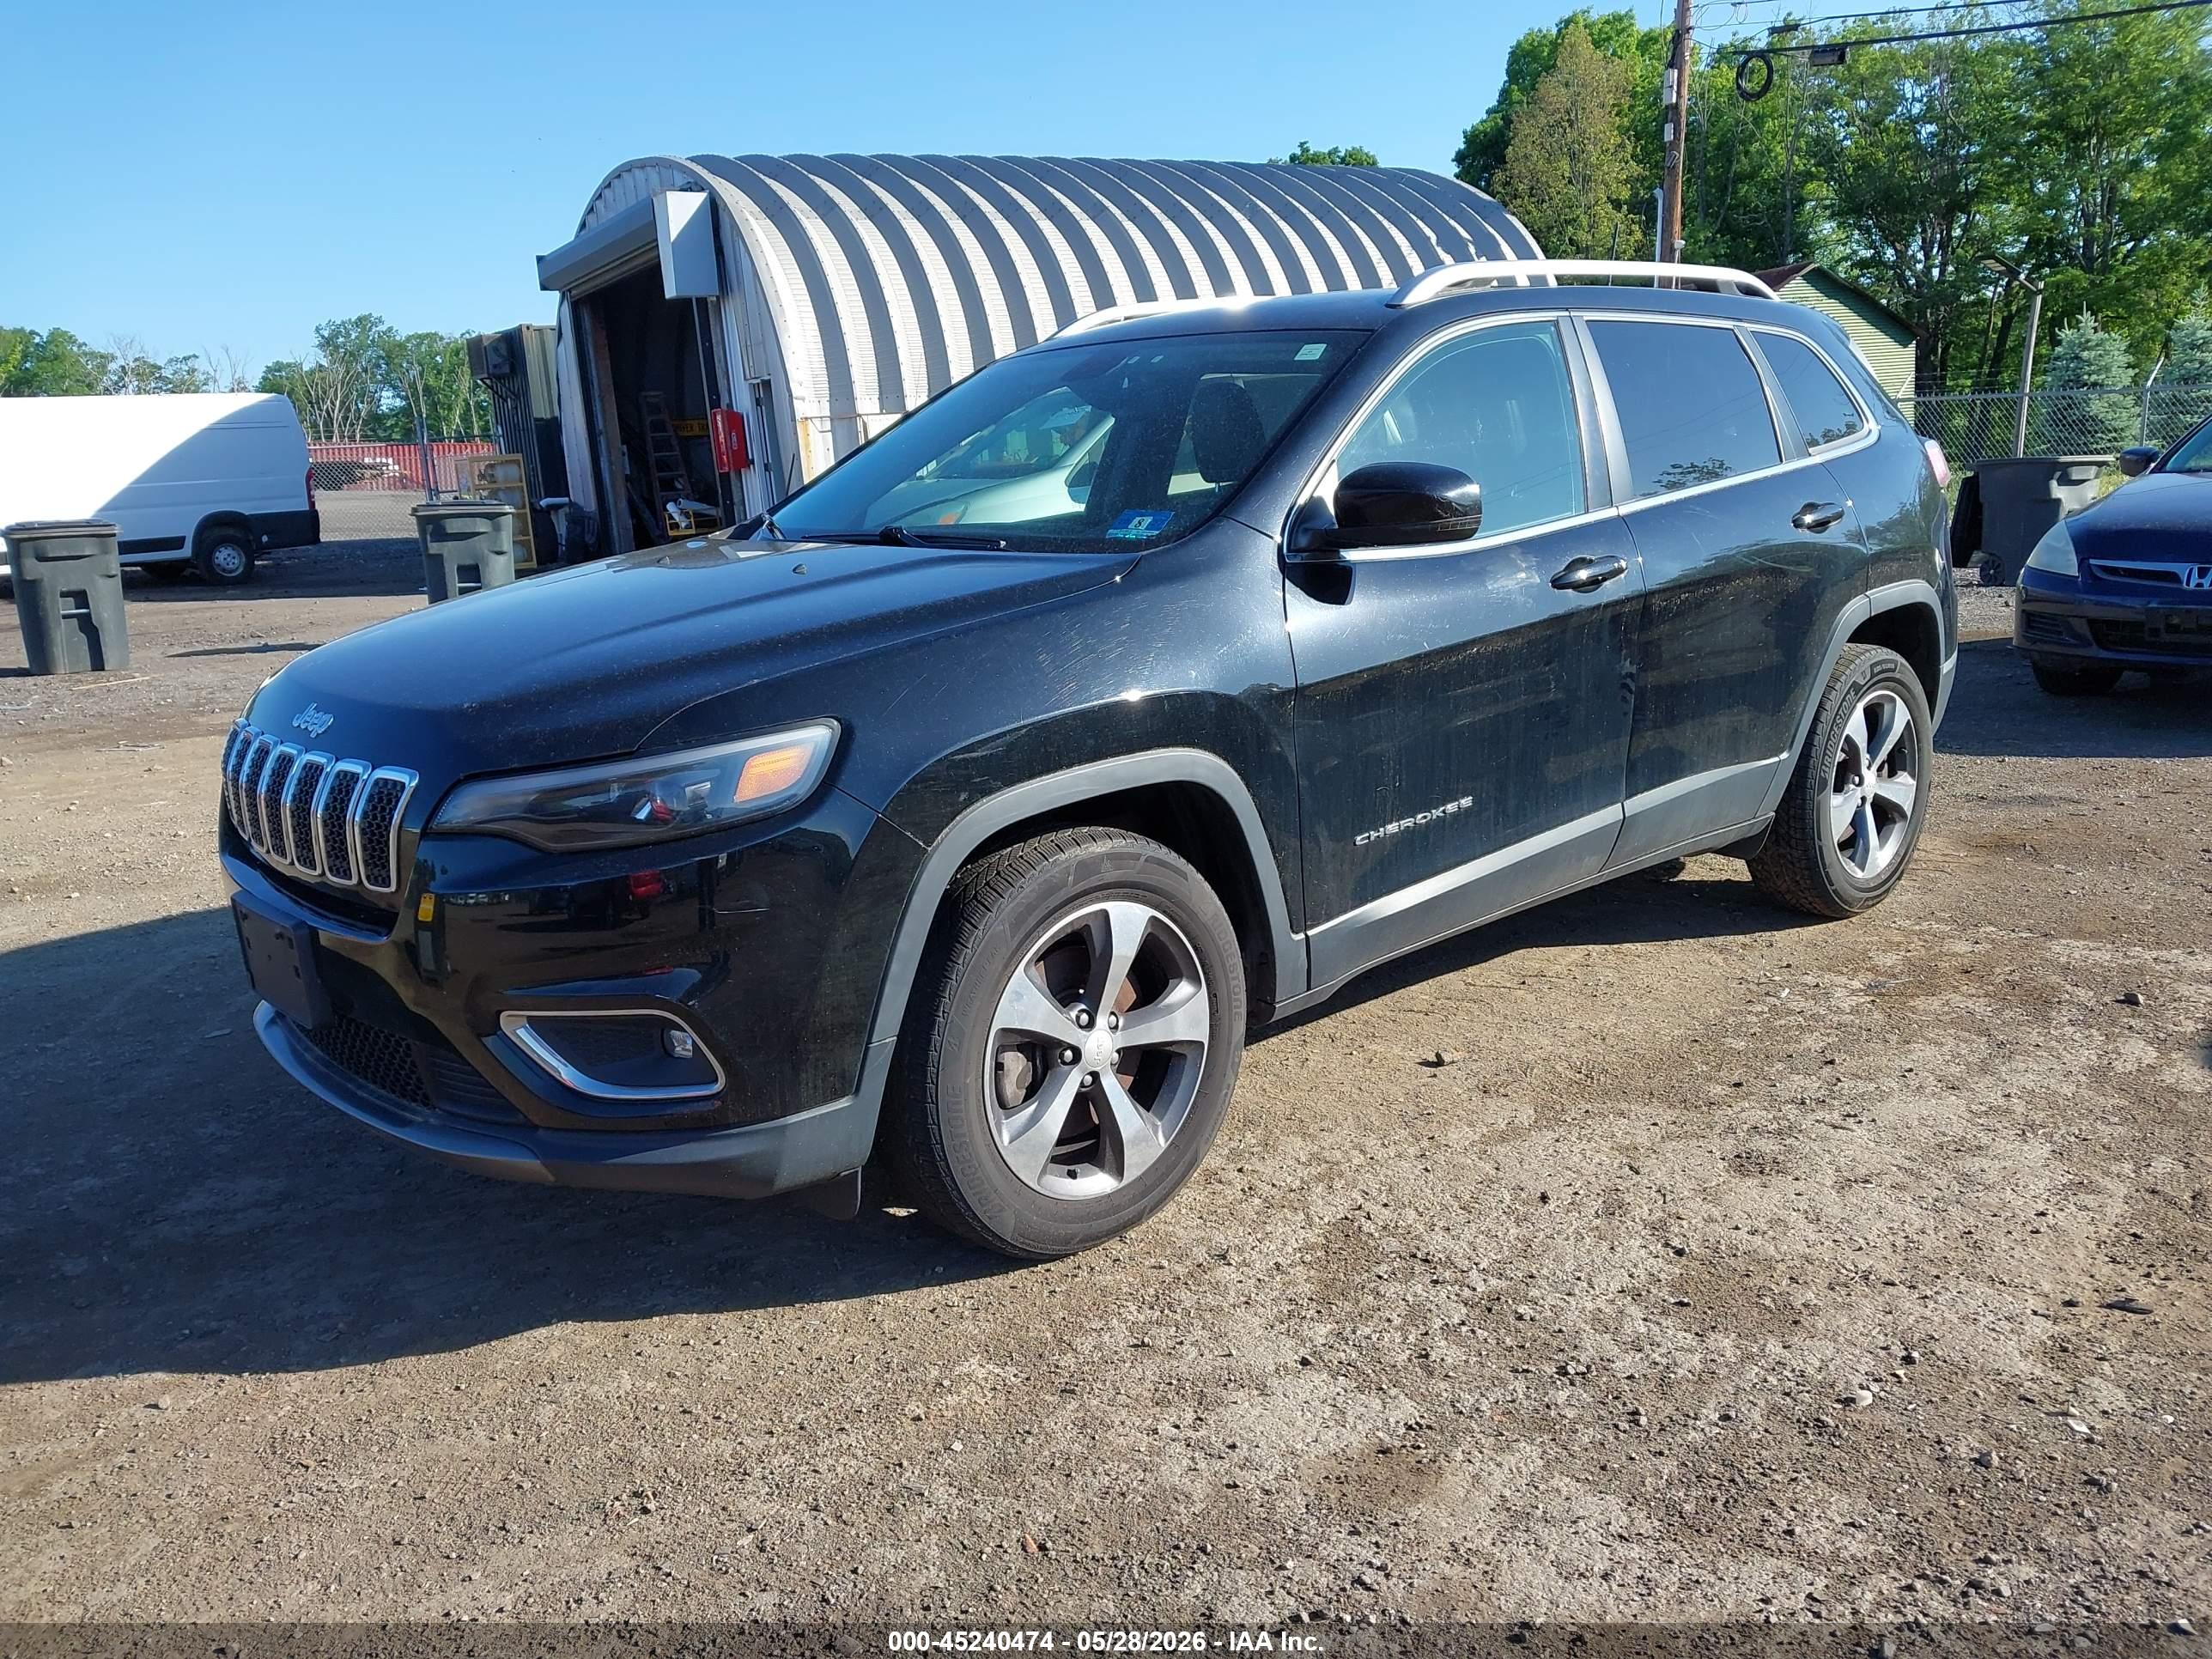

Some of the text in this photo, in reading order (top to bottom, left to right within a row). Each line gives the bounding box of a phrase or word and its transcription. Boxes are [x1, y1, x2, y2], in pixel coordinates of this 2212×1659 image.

[292, 701, 334, 738] Jeep
[1820, 687, 1857, 779] BRIDGESTONE
[1354, 795, 1474, 846] CHEROKEE
[1199, 904, 1243, 1023] BRIDGESTONE
[1093, 1036, 1104, 1065] Jeep
[945, 1084, 1003, 1219] BRIDGESTONE
